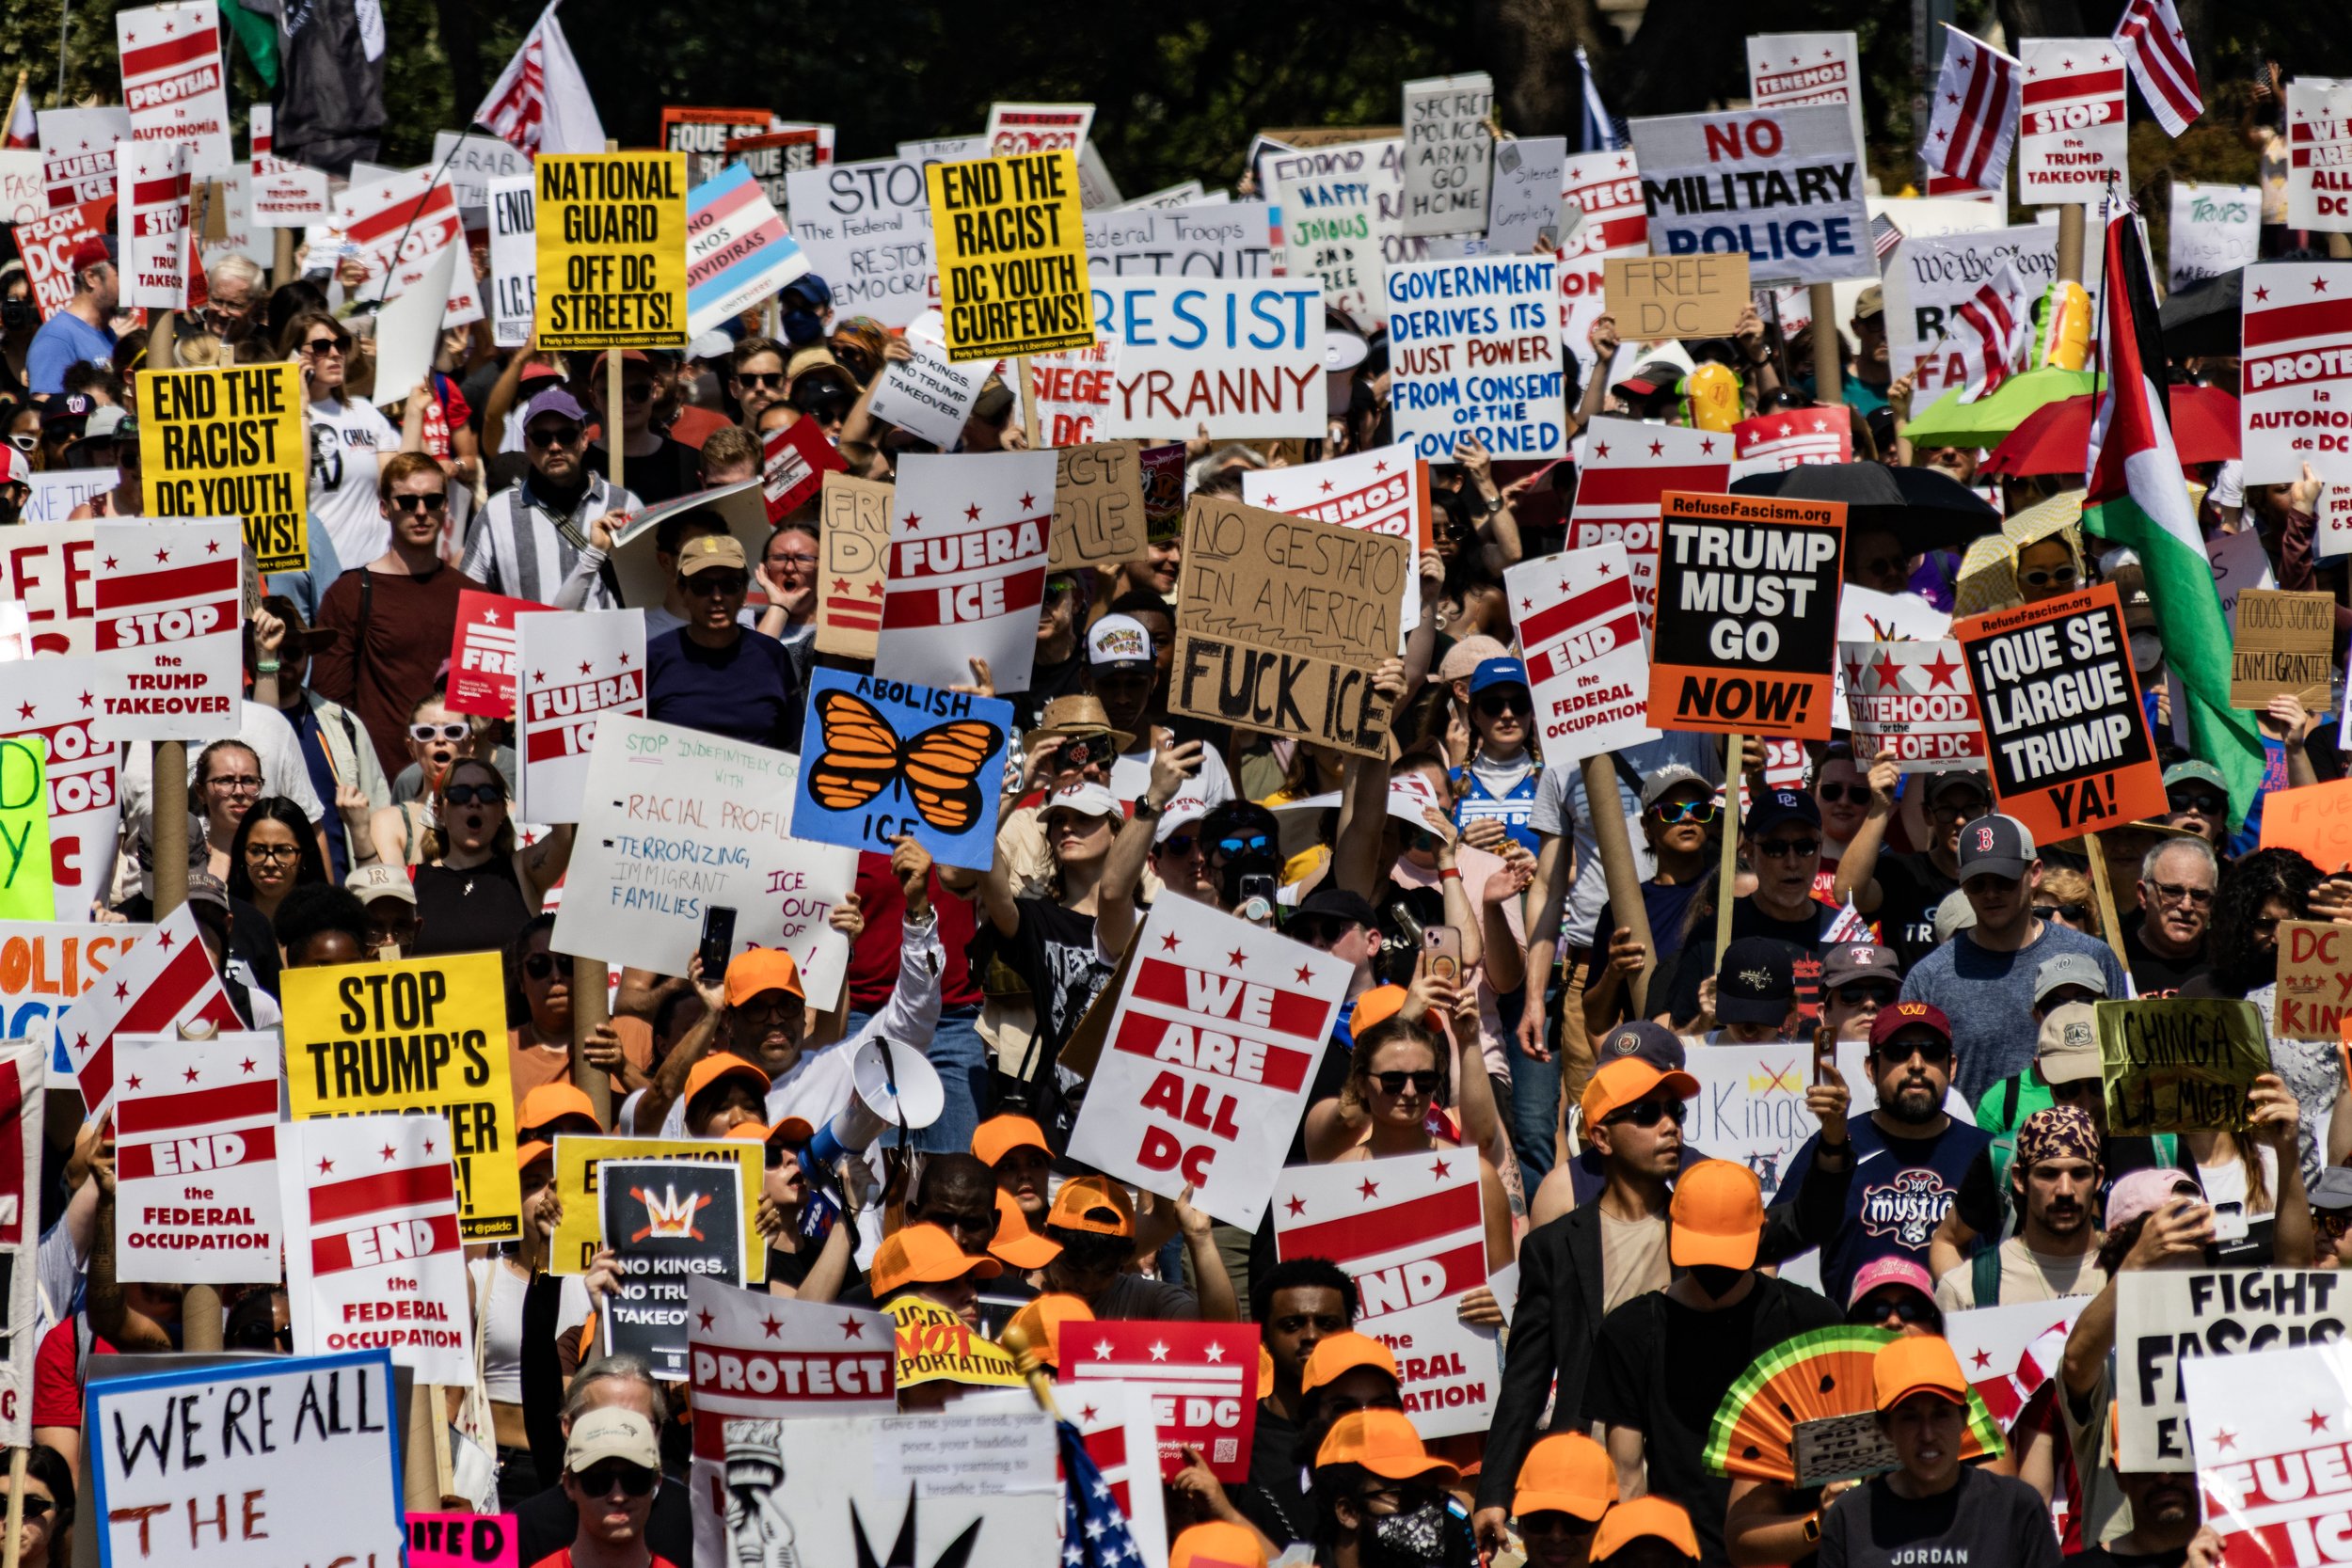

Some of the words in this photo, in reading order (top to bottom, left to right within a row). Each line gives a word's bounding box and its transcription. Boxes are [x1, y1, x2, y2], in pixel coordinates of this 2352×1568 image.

[129, 69, 217, 111] PROTEJA
[1758, 65, 1844, 94] TENEMOS
[1413, 93, 1494, 121] SECRET
[2035, 102, 2111, 135] STOP
[1413, 120, 1487, 141] POLICE
[1703, 119, 1784, 163] NO
[2064, 138, 2084, 149] the
[2310, 119, 2349, 141] WE
[1421, 144, 1488, 166] ARMY
[2045, 152, 2104, 166] TRUMP
[542, 162, 679, 201] NATIONAL
[942, 163, 1001, 209] END
[1007, 154, 1067, 201] THE
[1432, 168, 1468, 189] GO
[1642, 162, 1856, 218] MILITARY
[2027, 168, 2122, 184] TAKEOVER
[496, 190, 534, 235] END
[1413, 187, 1482, 215] HOME
[2190, 196, 2249, 224] TROOPS
[2317, 196, 2348, 216] DC
[16, 208, 84, 246] FROM
[564, 204, 658, 244] GUARD
[693, 228, 730, 255] NOS
[843, 213, 902, 239] Federal
[954, 202, 1062, 257] RACIST
[1165, 214, 1244, 245] Troops
[1666, 217, 1855, 262] POLICE
[23, 237, 72, 282] DC
[567, 255, 614, 293] OFF
[621, 254, 656, 291] DC
[1624, 259, 1721, 297] FREE
[951, 264, 989, 305] DC
[991, 254, 1079, 300] YOUTH
[1390, 263, 1557, 304] GOVERNMENT
[550, 293, 674, 331] STREETS!
[951, 293, 1088, 344] CURFEWS!
[1093, 290, 1321, 350] RESIST
[1392, 307, 1499, 344] DERIVES
[1510, 302, 1547, 330] ITS
[1640, 303, 1700, 333] DC
[928, 360, 971, 389] KINGS.
[1394, 343, 1455, 377] JUST
[1468, 336, 1553, 368] POWER
[151, 372, 216, 422] END
[222, 368, 285, 418] THE
[889, 376, 961, 420] TAKEOVER.
[919, 372, 968, 404] TRUMP
[1392, 376, 1459, 414] FROM
[1466, 372, 1563, 404] CONSENT
[2313, 389, 2330, 403] la
[1052, 414, 1094, 447] DC
[1453, 405, 1480, 425] OF
[1483, 402, 1527, 421] THE
[163, 418, 279, 471] RACIST
[1398, 421, 1561, 461] GOVERNED
[2291, 436, 2314, 450] de
[2317, 434, 2349, 452] DC
[156, 478, 195, 517] DC
[200, 472, 293, 516] YOUTH
[1674, 499, 1832, 524] RefuseFascism.org
[899, 520, 1042, 578] FUERA
[1194, 508, 1246, 557] NO
[1263, 523, 1399, 594] GESTAPO
[1669, 524, 1836, 573] TRUMP
[1634, 562, 1650, 577] la
[939, 578, 1006, 626] ICE
[1188, 565, 1234, 607] IN
[1253, 578, 1389, 652] AMERICA
[1681, 571, 1817, 618] MUST
[115, 605, 219, 648] STOP
[1982, 595, 2091, 633] RefuseFascism.org
[2242, 597, 2286, 629] TODOS
[2288, 599, 2332, 631] SOMOS
[1547, 627, 1616, 676] END
[1710, 619, 1780, 662] GO
[1979, 626, 2062, 693] ¡QUE
[2069, 611, 2117, 657] SE
[155, 656, 182, 667] the
[1578, 673, 1599, 687] the
[2233, 651, 2332, 685] INMIGRANTES
[127, 674, 208, 690] TRUMP
[532, 673, 640, 721] FUERA
[856, 676, 972, 718] ABOLISH
[1181, 637, 1311, 732] FUCK
[1677, 675, 1814, 723] NOW!
[1987, 662, 2128, 735] LARGUE
[104, 696, 230, 715] TAKEOVER
[1547, 702, 1647, 738] OCCUPATION
[1552, 685, 1633, 718] FEDERAL
[1851, 696, 1968, 721] STATEHOOD
[626, 734, 668, 755] STOP
[1880, 723, 1891, 733] for
[1893, 723, 1910, 733] the
[1901, 736, 1934, 759] OF
[1938, 735, 1971, 757] DC
[2002, 714, 2133, 784] TRUMP
[715, 769, 743, 788] WITH
[629, 795, 707, 829] RACIAL
[2048, 773, 2119, 830] YA!
[863, 814, 919, 843] ICE
[611, 862, 729, 894] IMMIGRANT
[766, 871, 807, 894] ICE
[612, 886, 699, 919] FAMILIES
[783, 898, 830, 922] OUT
[783, 923, 805, 938] OF
[2291, 928, 2339, 964] DC
[339, 970, 446, 1035] STOP
[1184, 968, 1276, 1028] WE
[1153, 1022, 1267, 1084] ARE
[2123, 1010, 2233, 1069] CHINGA
[1140, 1070, 1239, 1142] ALL
[1715, 1082, 1808, 1153] Kings
[2115, 1078, 2155, 1126] LA
[2178, 1081, 2254, 1125] MIGRA
[151, 1132, 246, 1176] END
[1136, 1125, 1216, 1189] DC
[183, 1186, 214, 1200] the
[143, 1207, 256, 1226] FEDERAL
[127, 1232, 269, 1250] OCCUPATION
[346, 1219, 436, 1268] END
[387, 1275, 418, 1291] the
[619, 1259, 649, 1275] NO
[653, 1258, 728, 1275] KINGS.
[616, 1285, 647, 1300] NO
[2189, 1272, 2337, 1317] FIGHT
[342, 1301, 448, 1323] FEDERAL
[326, 1329, 461, 1350] OCCUPATION
[693, 1350, 886, 1395] PROTECT
[293, 1370, 384, 1444] ALL
[1184, 1400, 1241, 1428] DC
[107, 1489, 269, 1559] THE
[1891, 1548, 1970, 1565] JORDAN
